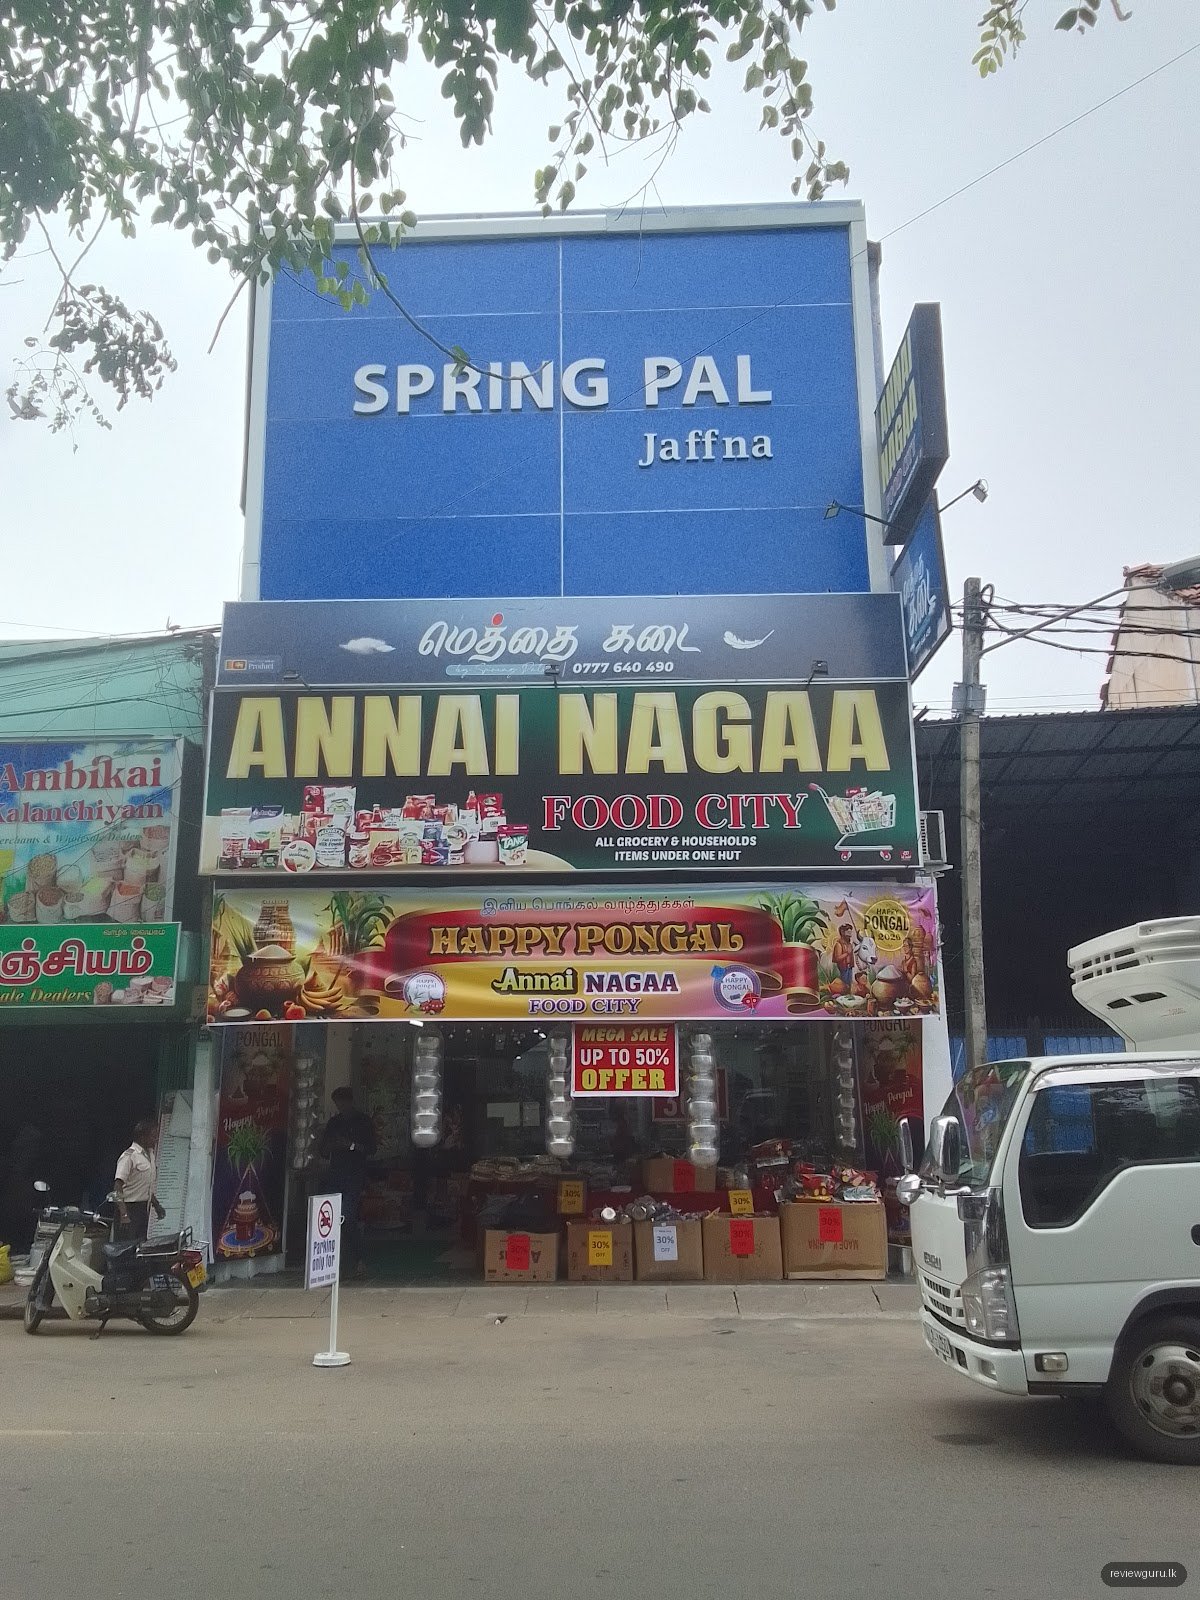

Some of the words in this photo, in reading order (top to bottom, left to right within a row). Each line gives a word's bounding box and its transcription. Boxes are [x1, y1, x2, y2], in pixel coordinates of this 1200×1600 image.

[353, 357, 609, 414] SPRING
[645, 354, 773, 406] PAL
[638, 428, 774, 468] Jaffna
[418, 612, 579, 663] மெத்தை
[602, 622, 701, 653] கடை
[573, 662, 609, 673] 0777
[613, 662, 642, 673] 640
[645, 661, 674, 673] 490
[226, 693, 520, 779] ANNAI
[558, 690, 892, 775] NAGAA
[0, 755, 161, 792] Ambikai
[541, 794, 684, 831] FOOD
[695, 793, 809, 829] CITY
[43, 835, 50, 843] &
[500, 836, 525, 849] TANG
[595, 837, 614, 847] ALL
[616, 836, 669, 847] GROCERY
[671, 836, 680, 846] &
[681, 836, 757, 846] HOUSEHOLDS
[615, 851, 649, 861] ITEMS
[651, 850, 690, 860] UNDER
[692, 850, 716, 860] ONE
[718, 850, 742, 860] HUT
[481, 897, 527, 917] இனிய
[532, 896, 600, 912] பொங்கல்
[863, 914, 909, 931] PONGAL
[429, 922, 572, 957] HAPPY
[576, 920, 745, 955] PONGAL
[491, 967, 578, 995] Annai
[585, 973, 680, 994] NAGAA
[30, 988, 92, 1002] Dealers
[528, 999, 587, 1014] FOOD
[591, 999, 641, 1013] CITY
[581, 1028, 626, 1042] MEGA
[630, 1028, 668, 1042] SALE
[580, 1048, 604, 1066] UP
[608, 1048, 630, 1066] TO
[635, 1048, 670, 1066] 50%
[581, 1068, 666, 1090] OFFER
[563, 1190, 581, 1198] 30%
[733, 1197, 750, 1205] 30%
[313, 1239, 336, 1255] Parking
[591, 1241, 610, 1249] 30%
[656, 1236, 675, 1244] 30%
[312, 1256, 325, 1271] only
[325, 1254, 336, 1268] for
